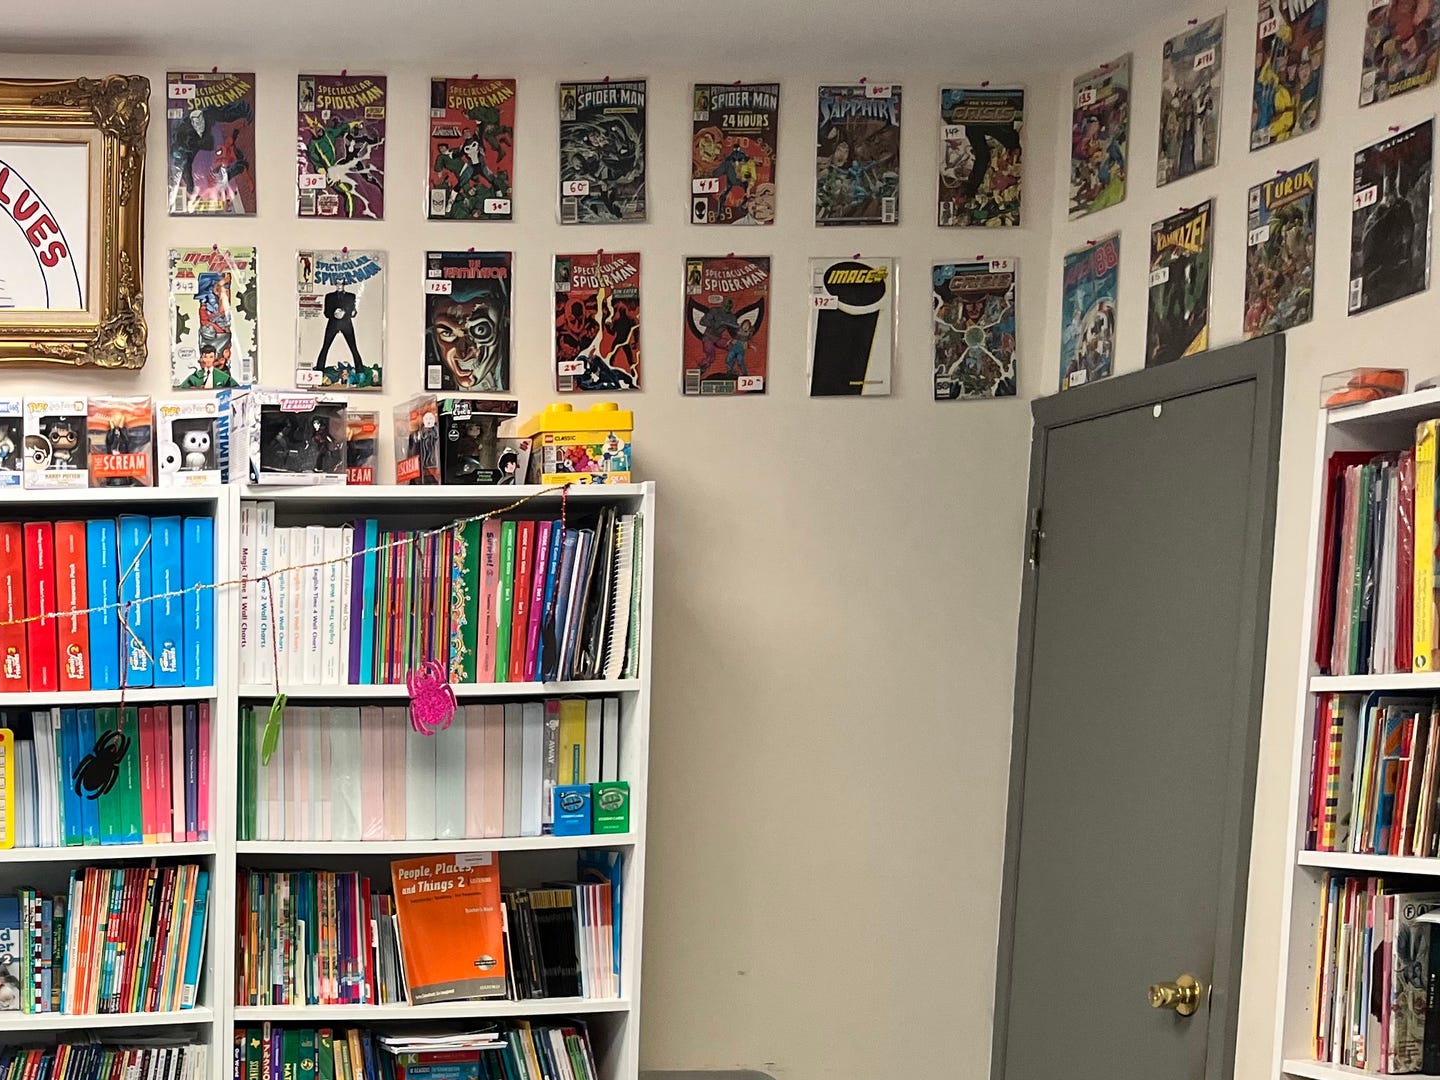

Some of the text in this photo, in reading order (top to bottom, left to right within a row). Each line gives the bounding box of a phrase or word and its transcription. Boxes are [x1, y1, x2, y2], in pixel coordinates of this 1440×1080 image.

[318, 79, 374, 94] SPECTACULAR
[449, 81, 505, 96] SPECTACULAR
[722, 114, 769, 128] 24 HOURS
[1263, 168, 1315, 209] TUROK
[315, 255, 372, 272] SPECTACULAR
[705, 264, 758, 280] SPECTACULAR
[827, 270, 876, 285] IMAGE
[554, 434, 576, 442] CLASSIC
[103, 455, 145, 471] SCREAM
[398, 864, 433, 880] People,
[402, 876, 466, 896] and Things 2
